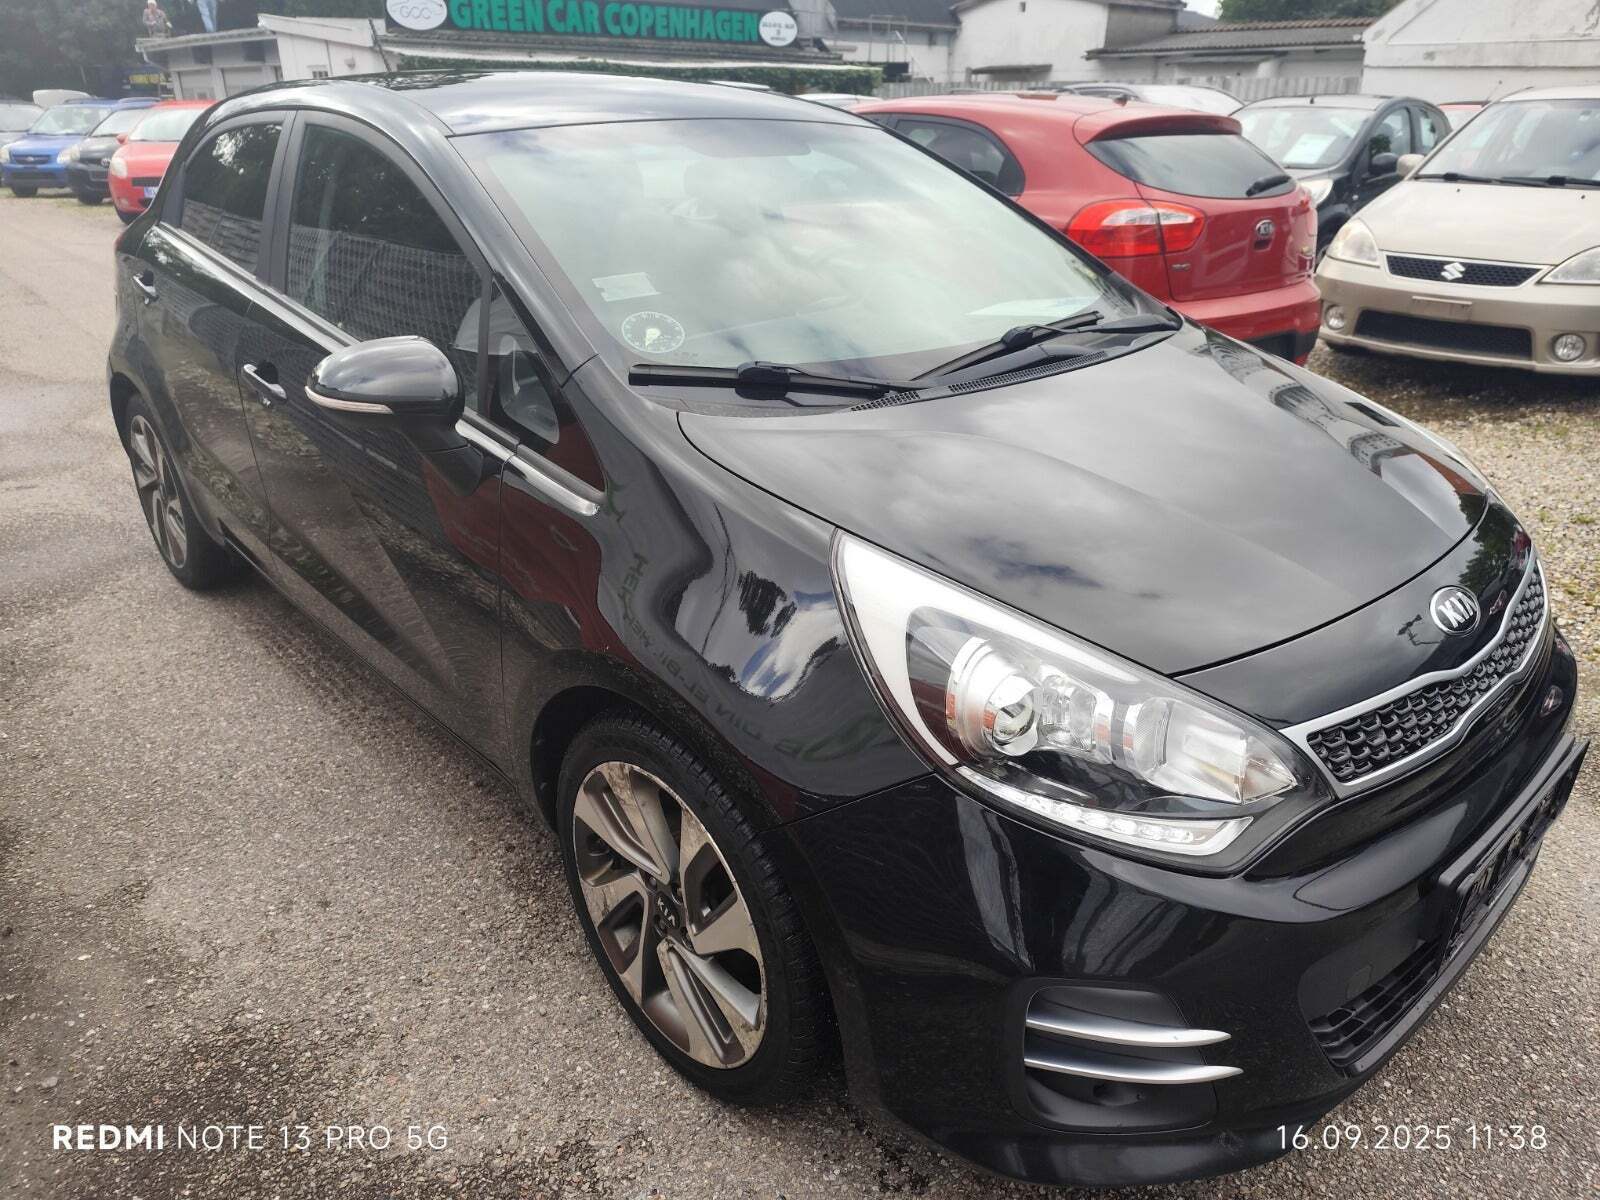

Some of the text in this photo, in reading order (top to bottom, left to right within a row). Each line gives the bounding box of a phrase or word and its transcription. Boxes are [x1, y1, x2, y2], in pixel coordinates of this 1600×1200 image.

[450, 0, 759, 43] GREEN CAR COPENHAGEN
[1437, 591, 1478, 629] KIA
